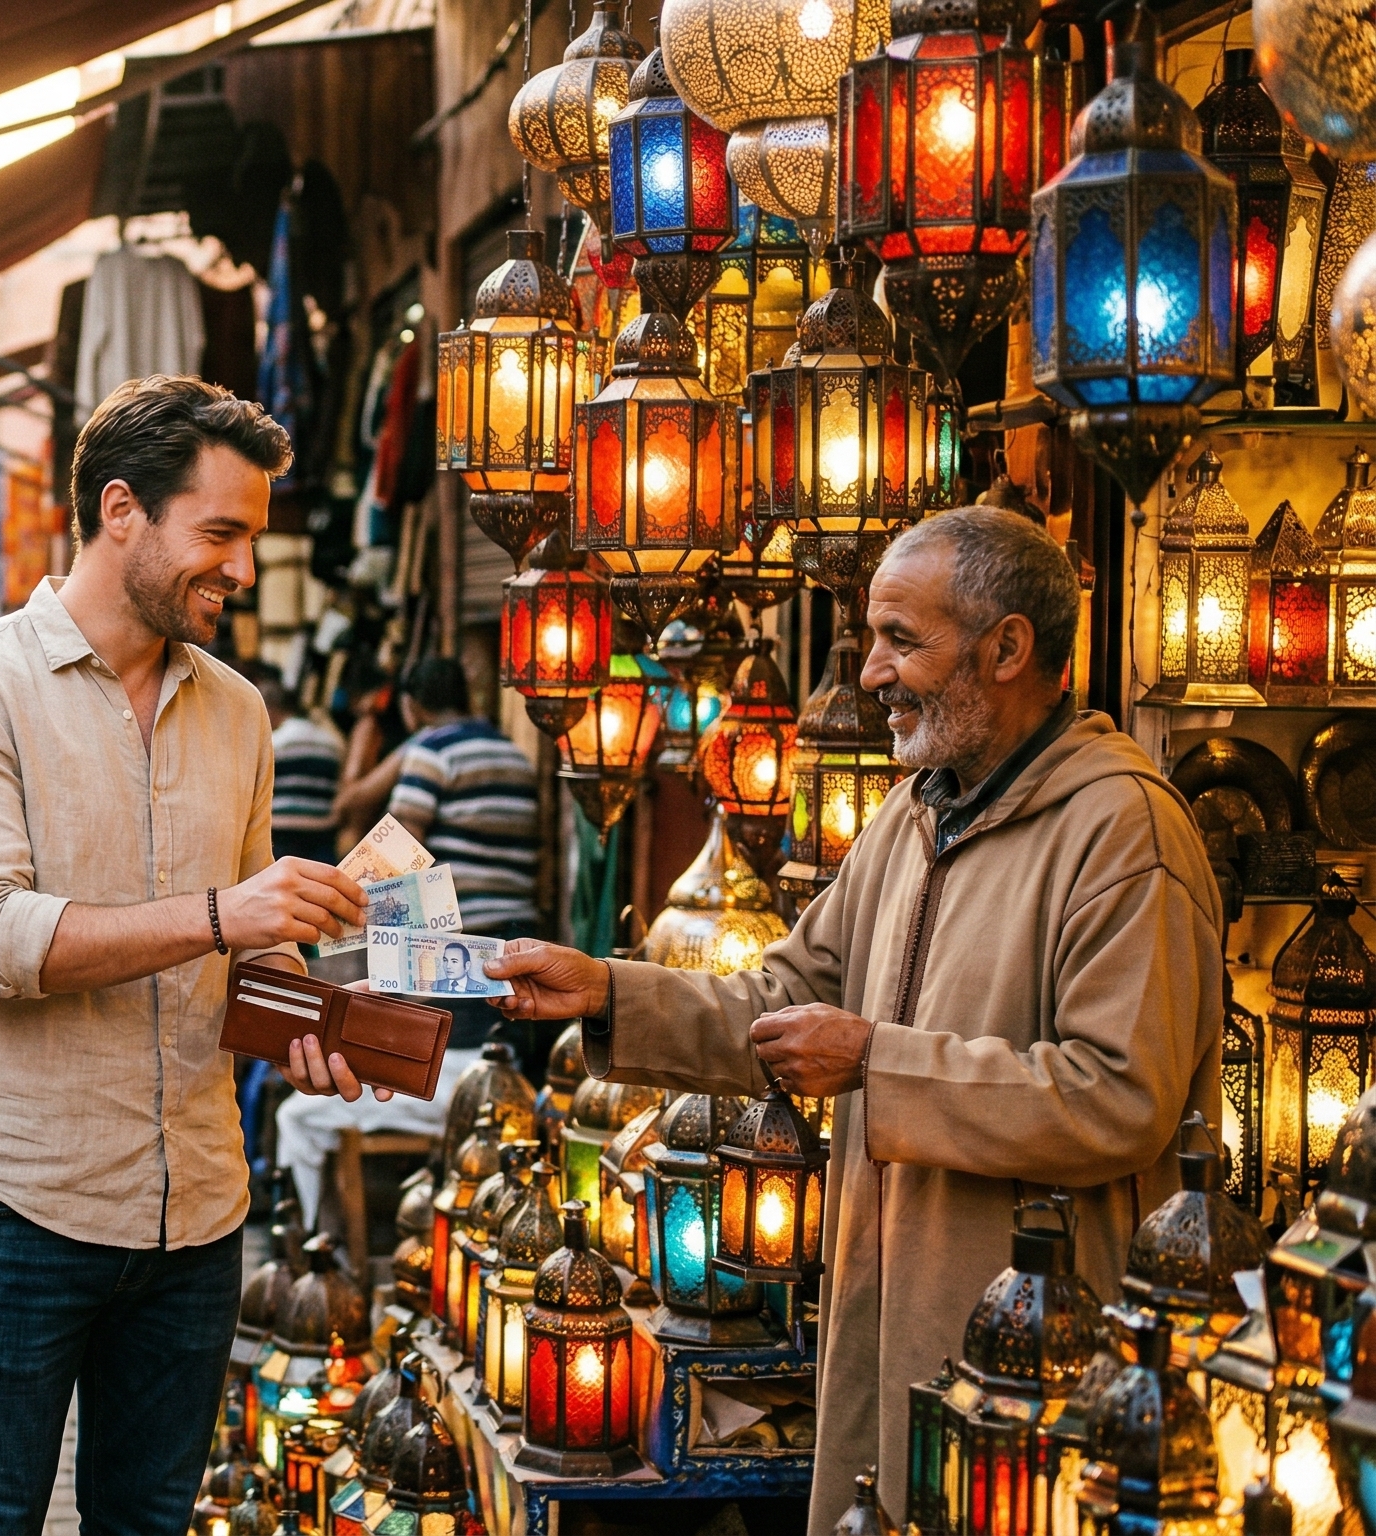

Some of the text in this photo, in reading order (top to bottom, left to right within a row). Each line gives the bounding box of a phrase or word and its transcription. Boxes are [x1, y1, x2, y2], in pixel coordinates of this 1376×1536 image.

[372, 820, 395, 844] 100
[430, 912, 456, 929] 200
[372, 930, 399, 946] 200
[379, 979, 398, 989] 200
